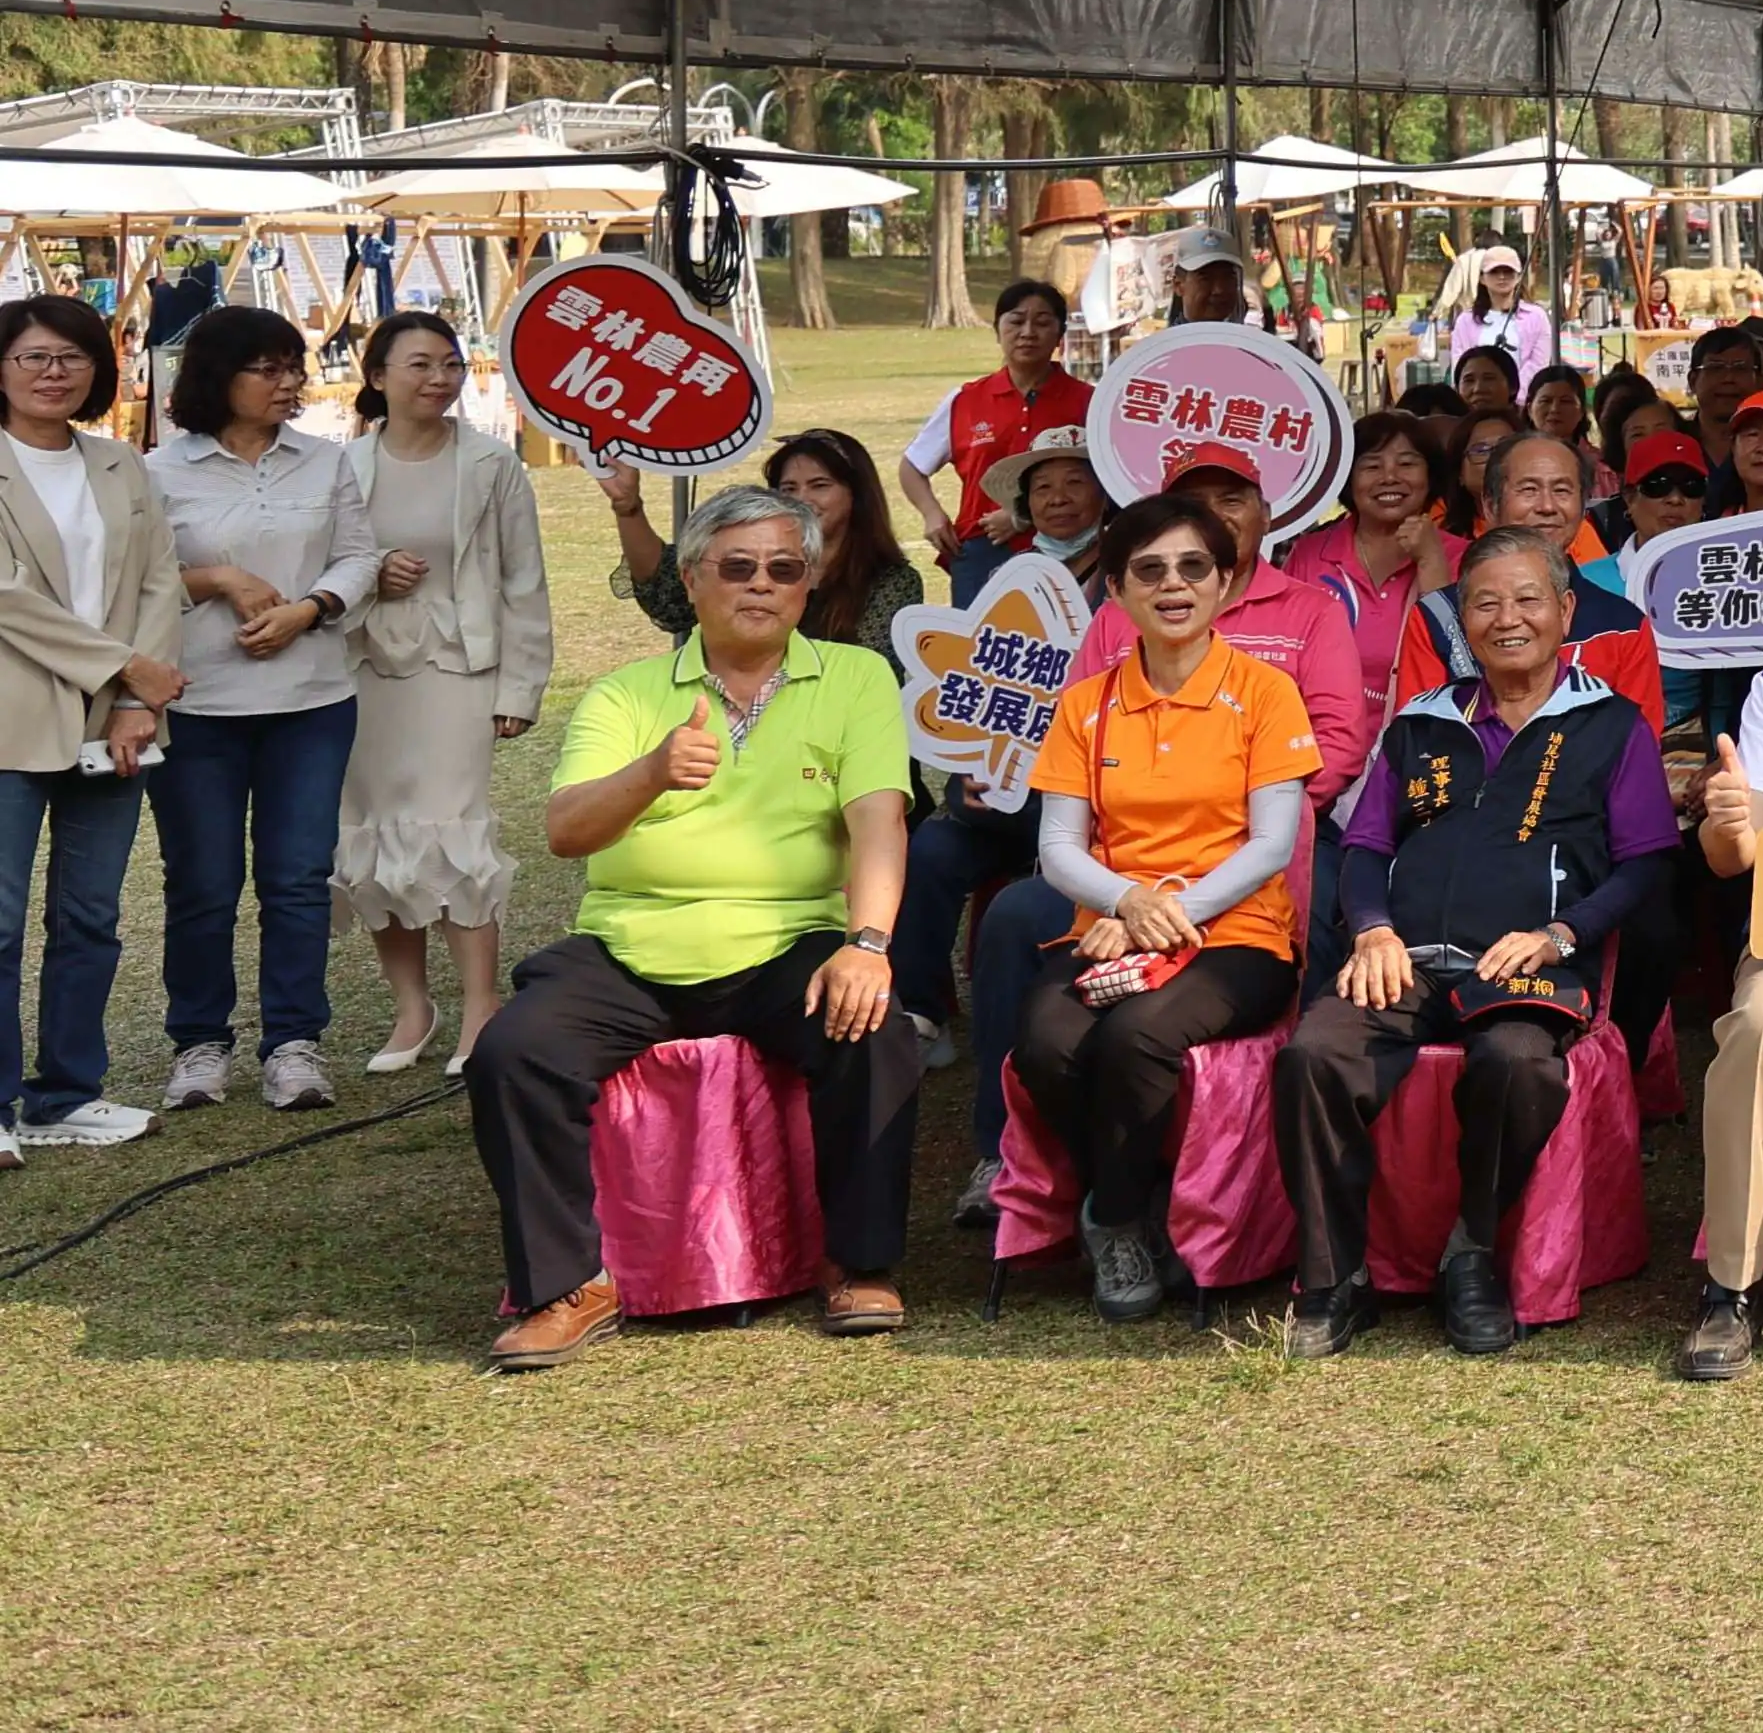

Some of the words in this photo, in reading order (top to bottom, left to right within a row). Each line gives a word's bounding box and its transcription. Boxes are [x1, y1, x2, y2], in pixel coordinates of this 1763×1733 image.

[545, 285, 739, 397] 雲林農再
[550, 346, 677, 433] No.1
[1122, 378, 1314, 452] 雲林農村
[972, 627, 1071, 691] 城鄉
